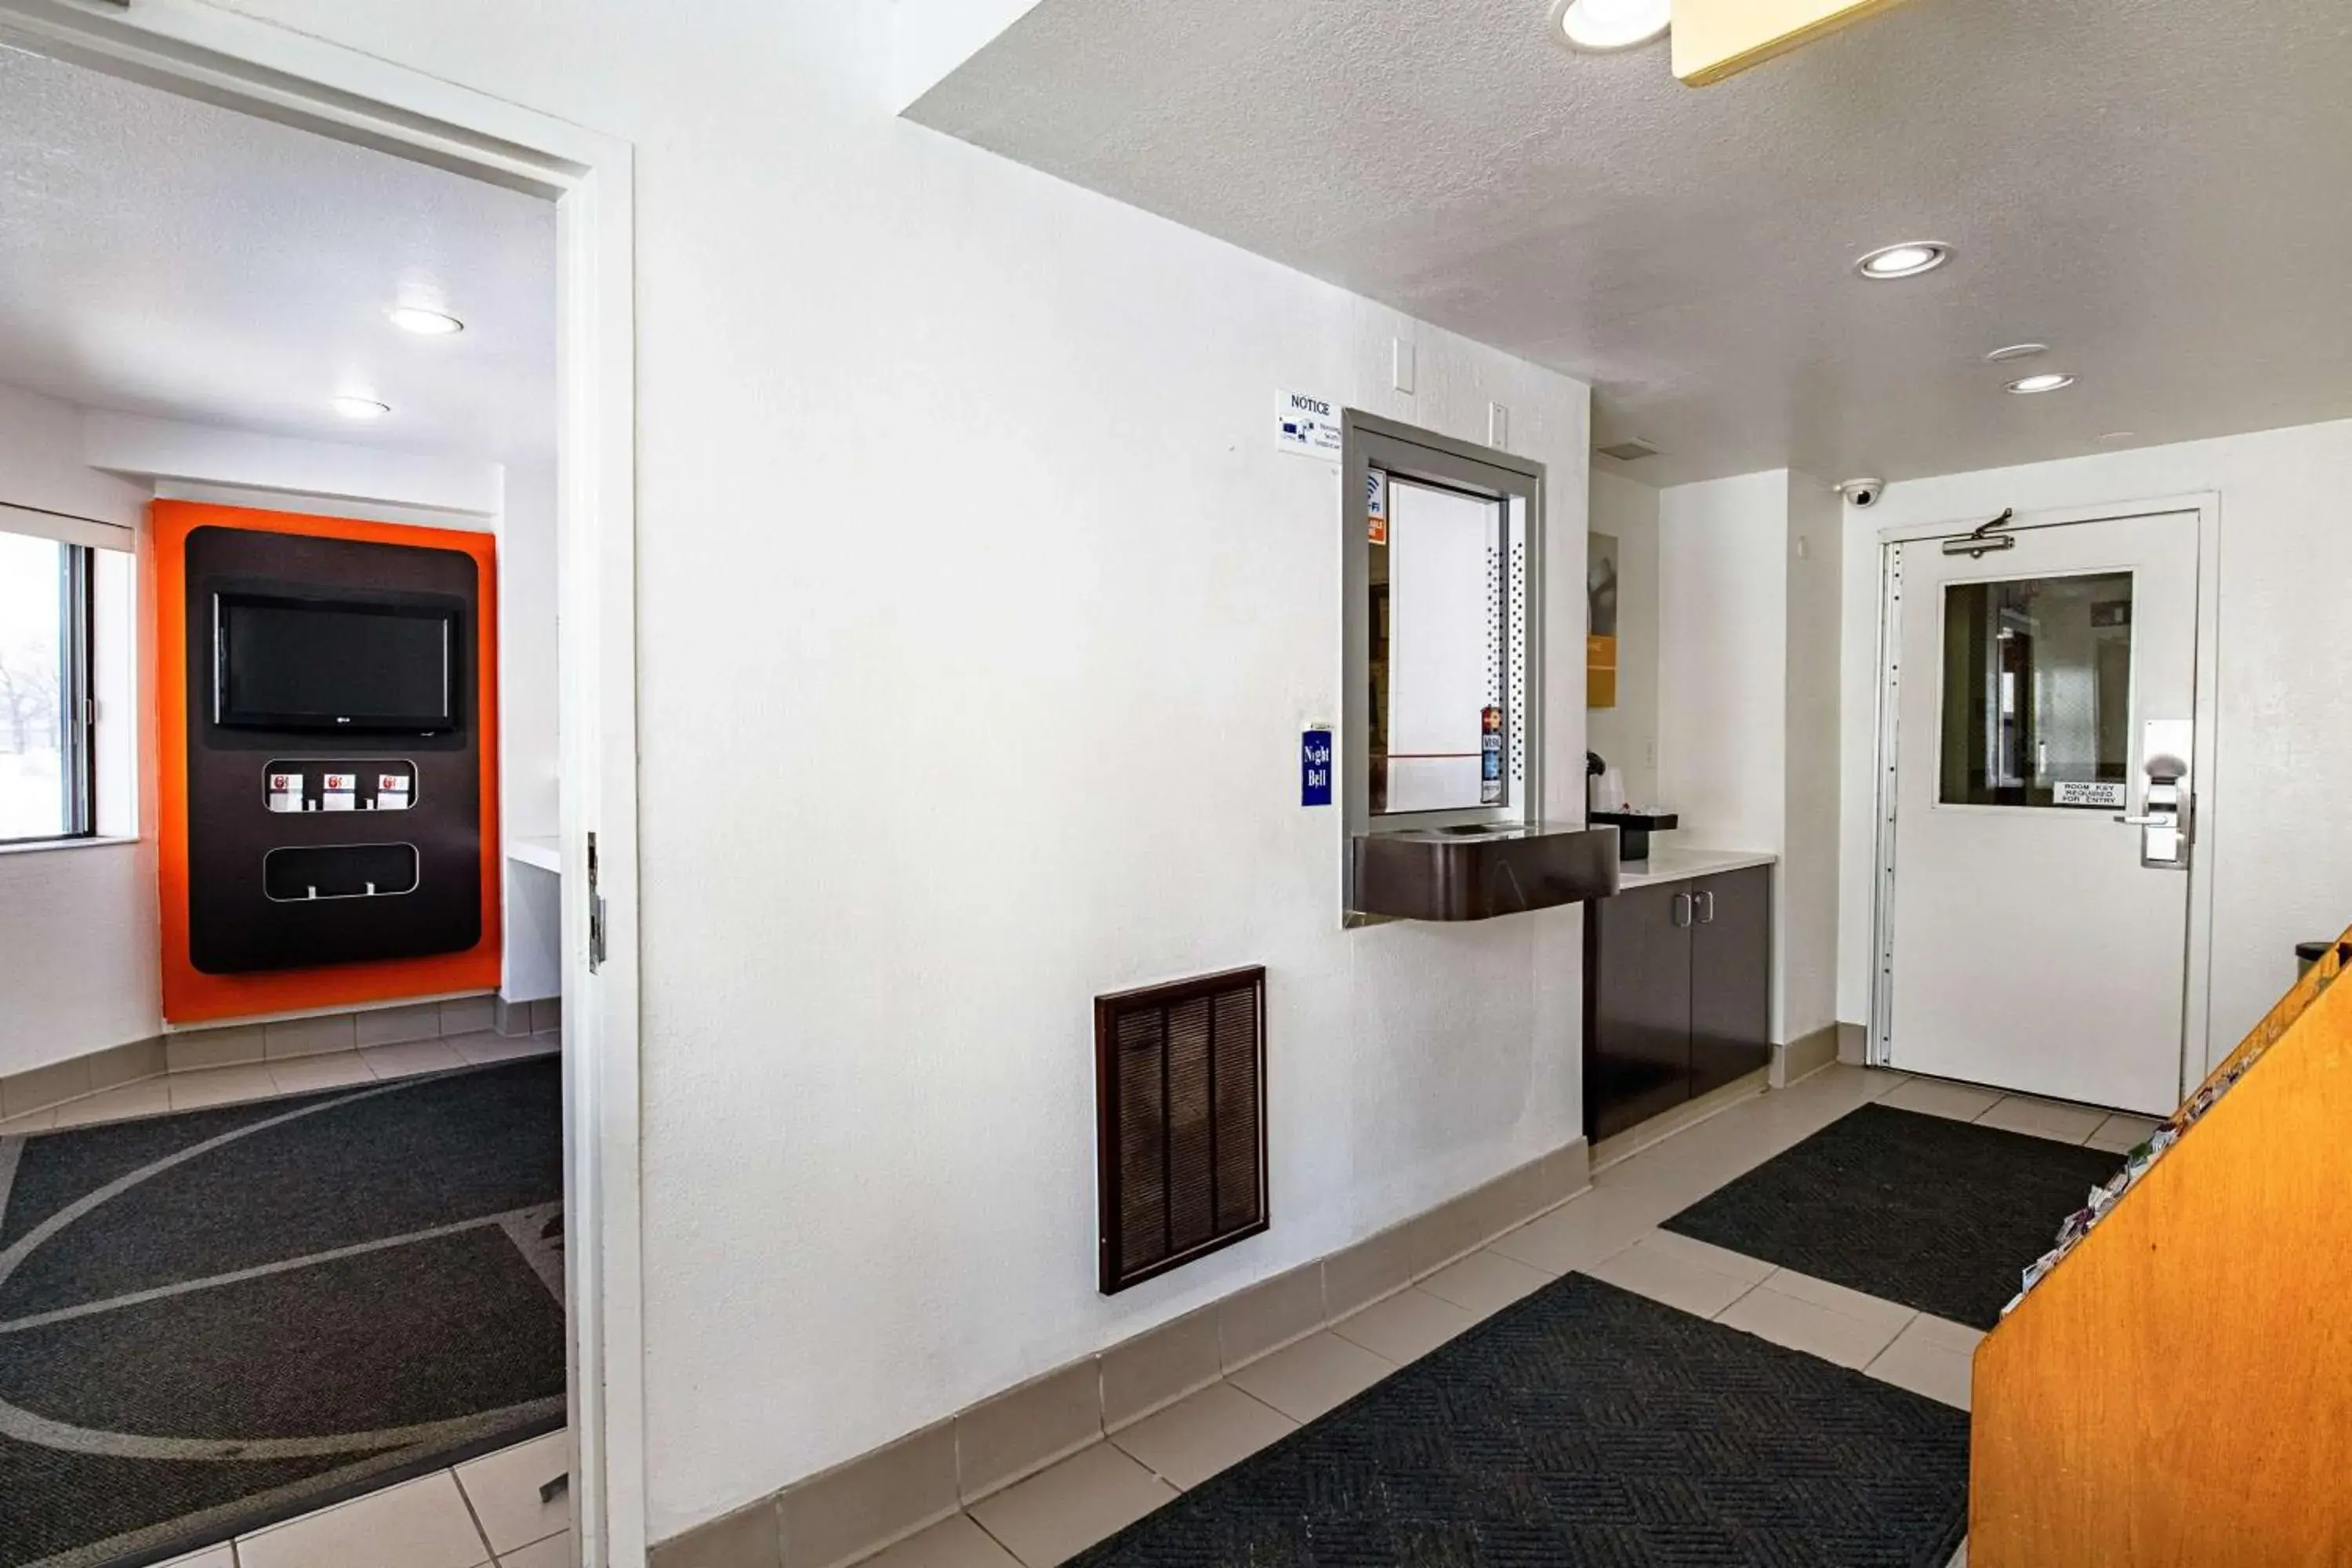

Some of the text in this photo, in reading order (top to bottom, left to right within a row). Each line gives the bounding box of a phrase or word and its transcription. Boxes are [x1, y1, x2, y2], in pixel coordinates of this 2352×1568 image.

[1291, 394, 1330, 416] NOTICE
[1304, 746, 1330, 765] Night
[1308, 769, 1327, 786] Bell
